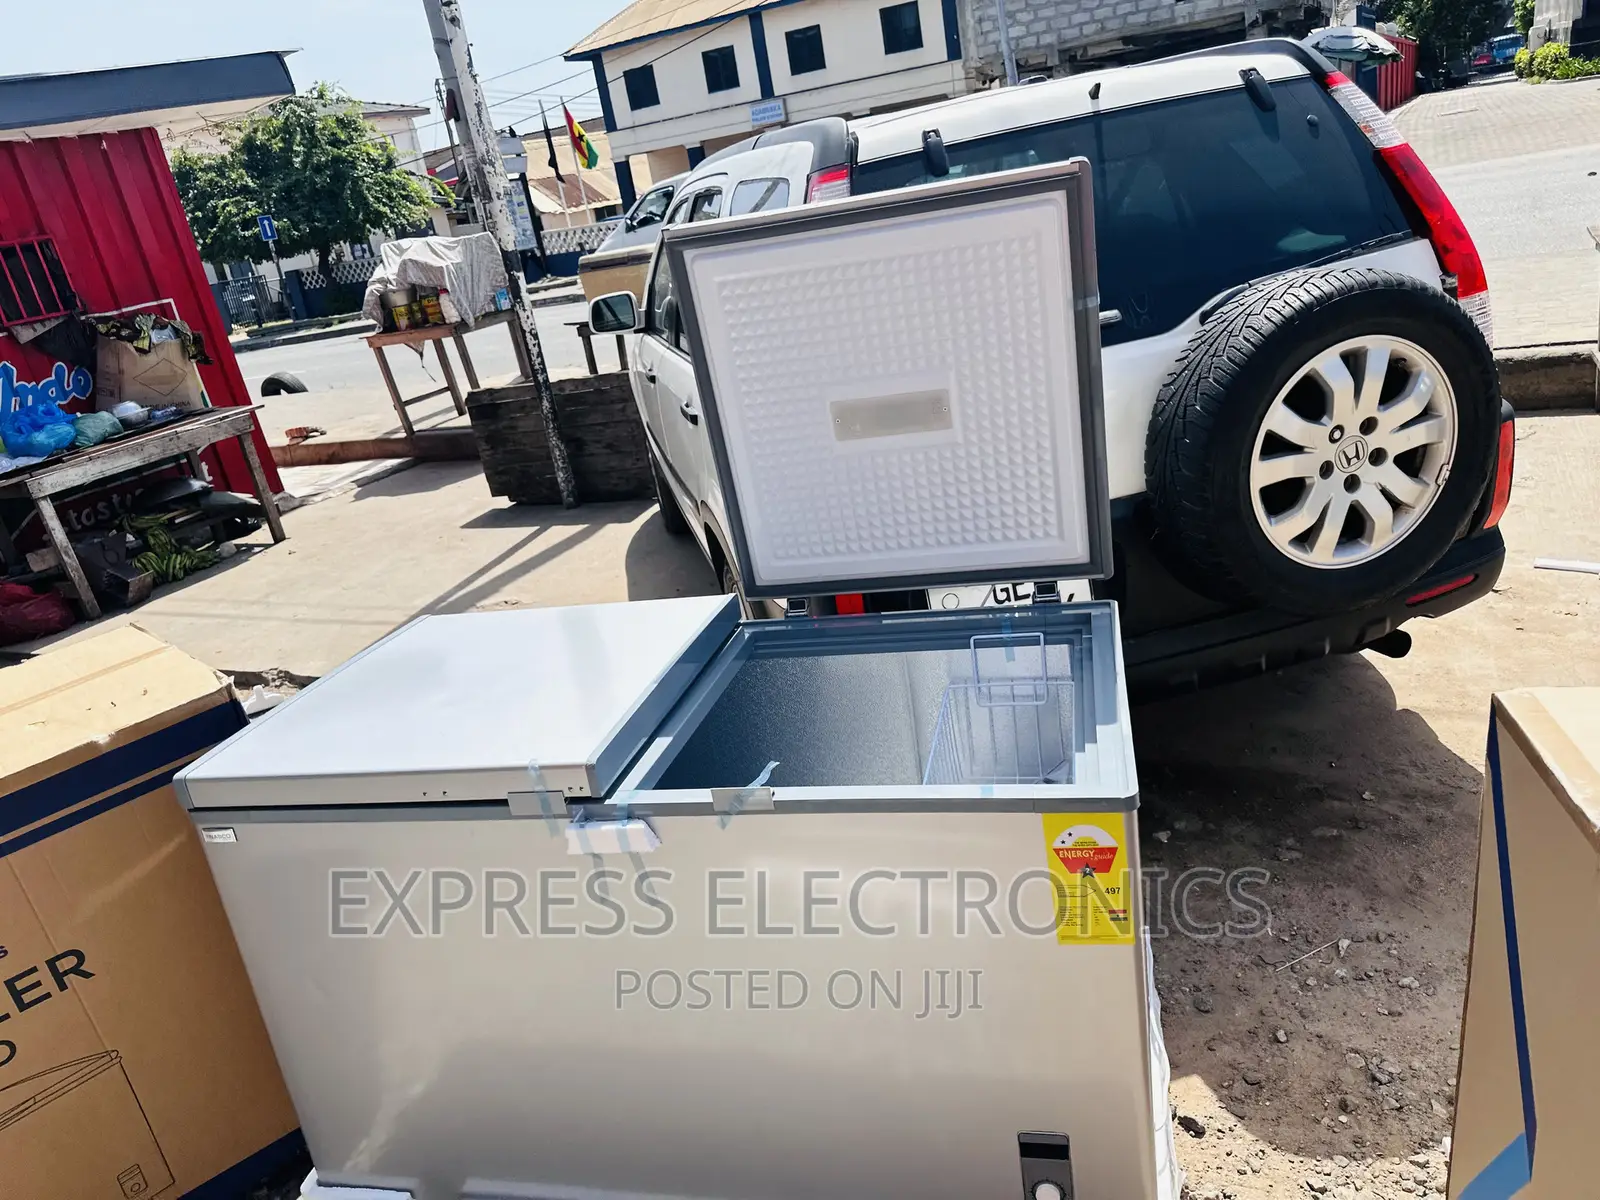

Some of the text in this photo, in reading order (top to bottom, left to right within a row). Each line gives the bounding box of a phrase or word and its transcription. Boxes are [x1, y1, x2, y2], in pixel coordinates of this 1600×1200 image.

[1059, 848, 1114, 861] ENERGY guide
[1104, 887, 1121, 895] 497
[0, 948, 96, 1023] ER
